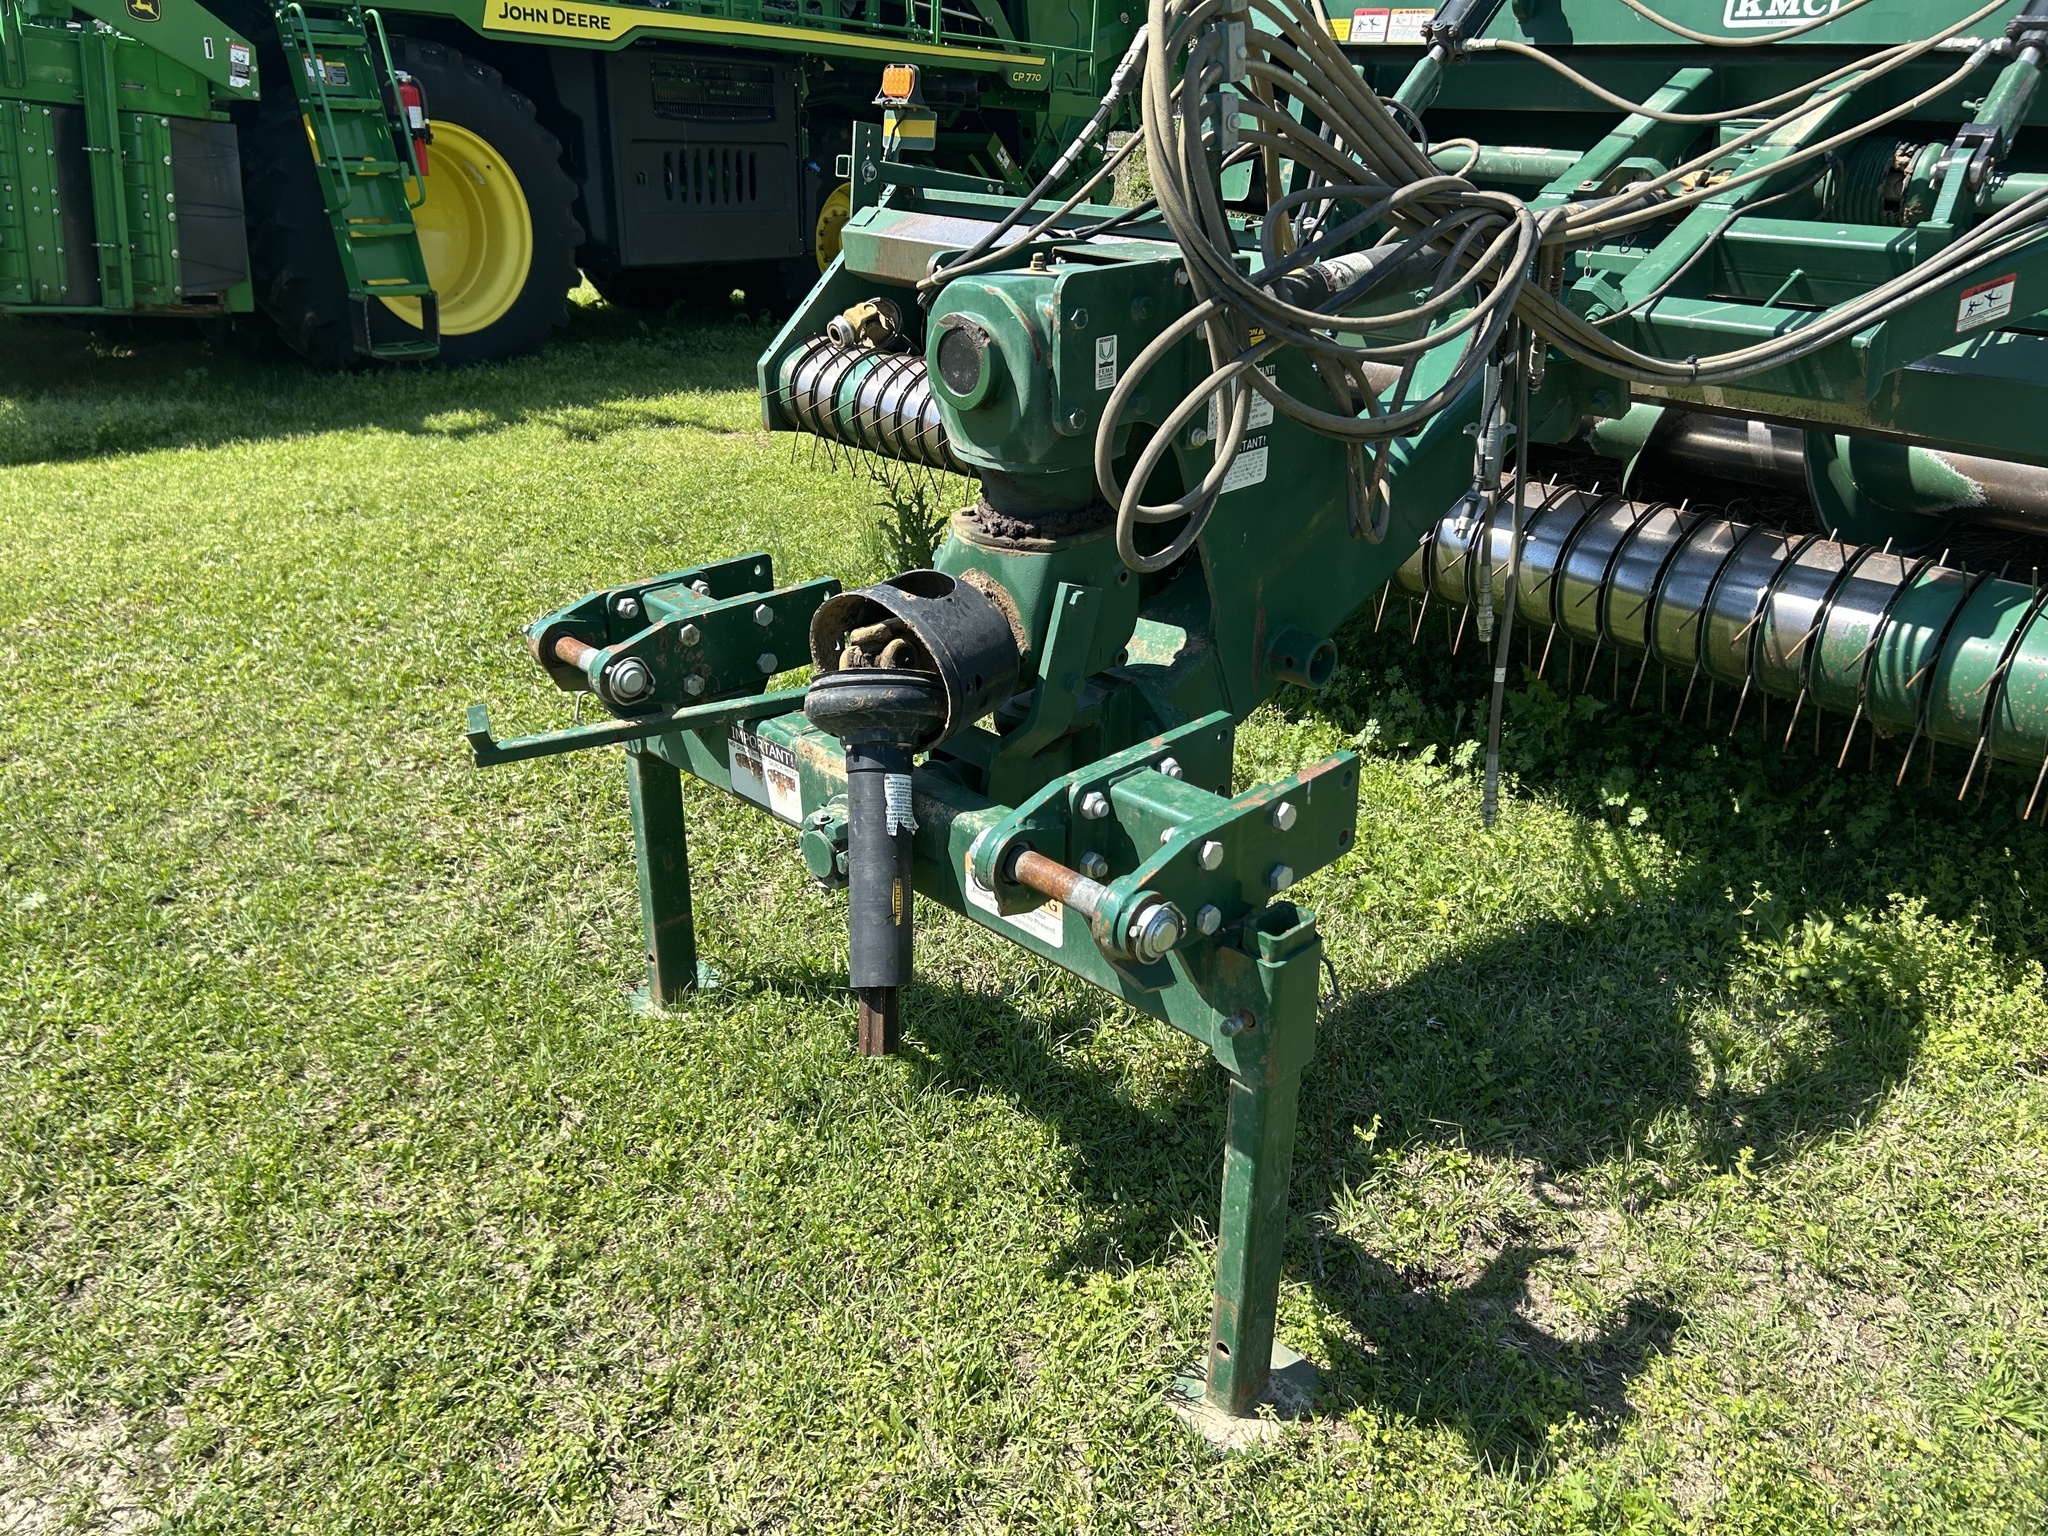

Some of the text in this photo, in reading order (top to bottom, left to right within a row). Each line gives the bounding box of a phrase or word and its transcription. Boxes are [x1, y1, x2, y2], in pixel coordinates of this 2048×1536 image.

[498, 1, 612, 30] JOHN DEERE
[1734, 0, 1828, 17] KMC
[205, 38, 213, 58] 1
[1012, 71, 1042, 83] CP 770
[1098, 366, 1114, 375] FEMA
[731, 726, 795, 767] IMPORTANT!
